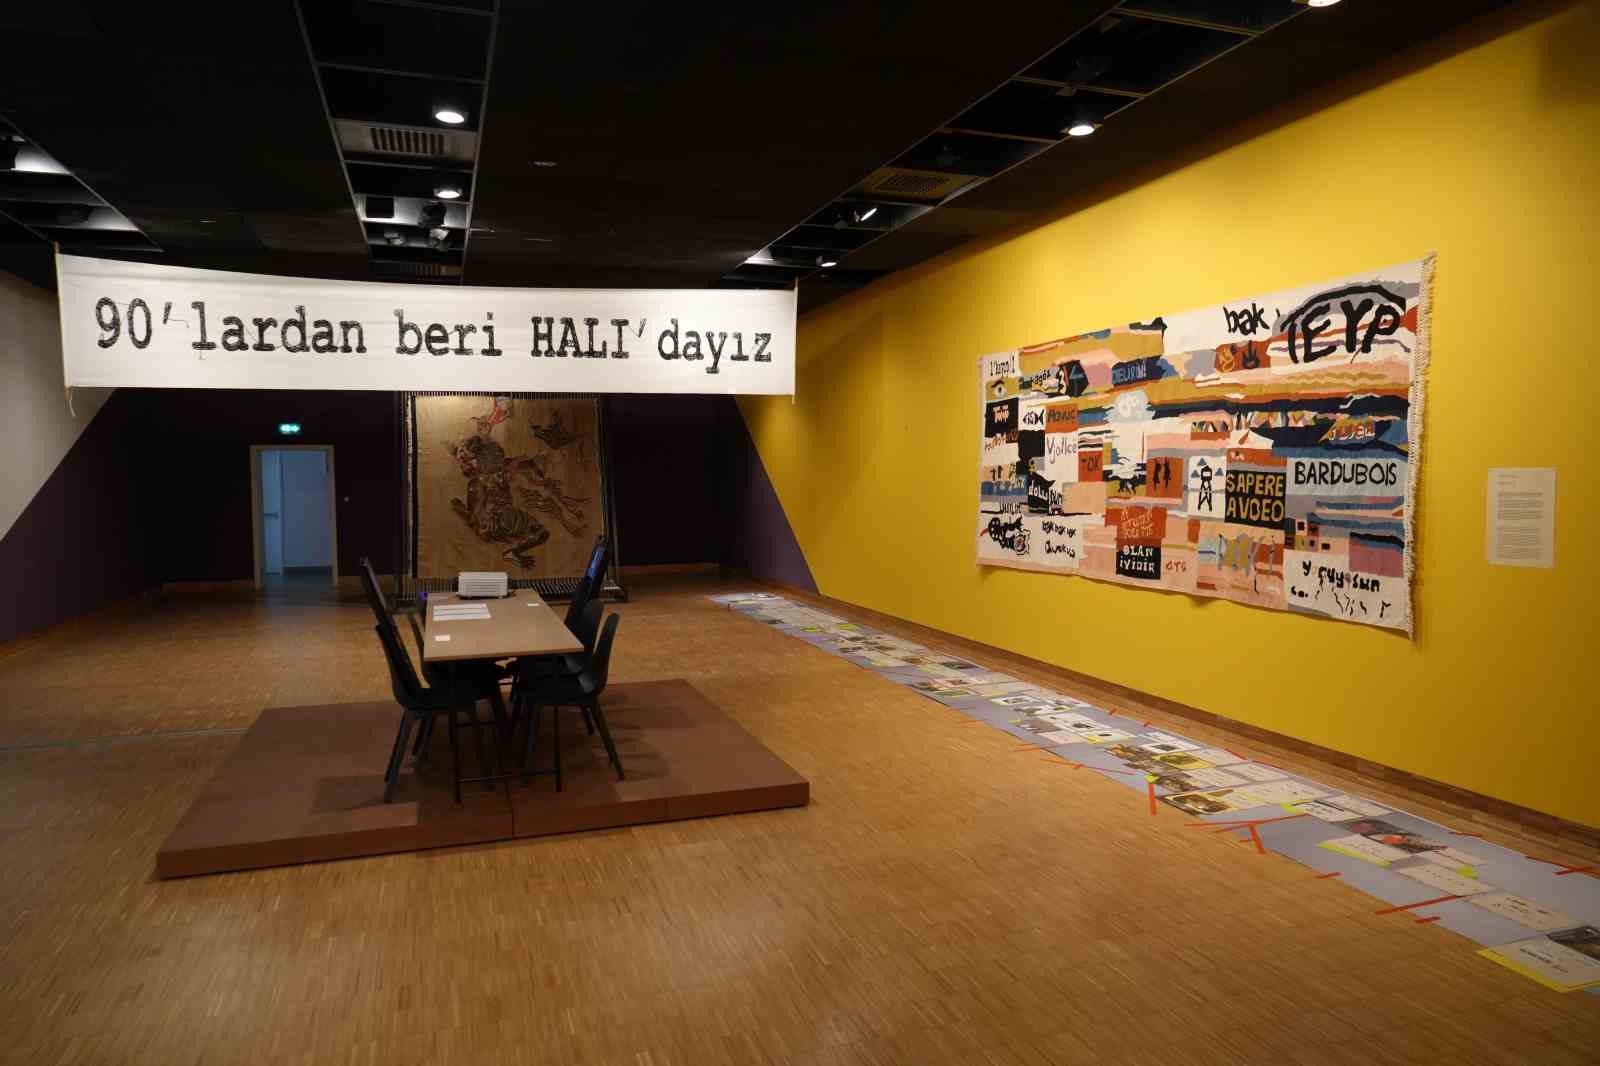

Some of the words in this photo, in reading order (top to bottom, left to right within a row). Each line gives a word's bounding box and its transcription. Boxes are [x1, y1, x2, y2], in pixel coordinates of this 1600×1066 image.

[394, 309, 503, 356] beri
[1223, 303, 1270, 336] bak
[1226, 473, 1286, 496] SAPERE
